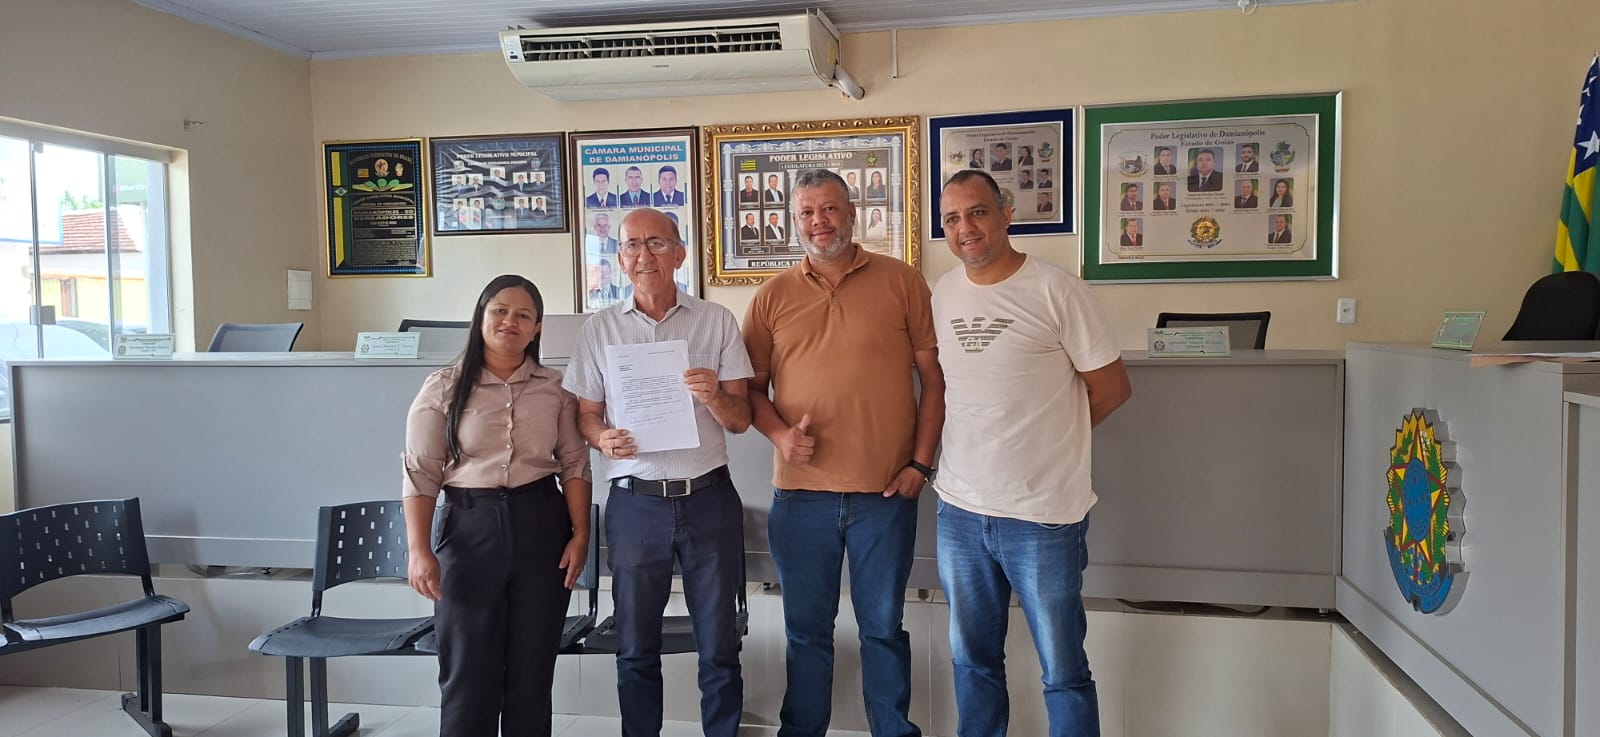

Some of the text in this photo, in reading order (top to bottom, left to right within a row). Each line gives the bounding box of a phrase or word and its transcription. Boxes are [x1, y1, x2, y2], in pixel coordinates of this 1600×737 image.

[1151, 132, 1169, 140] Poder
[1171, 131, 1207, 141] Legislativo
[585, 145, 683, 155] CÂMARA MUNICIPAL
[769, 152, 852, 162] PODER LEGISLATIVO
[751, 259, 790, 267] REPÚBLICA
